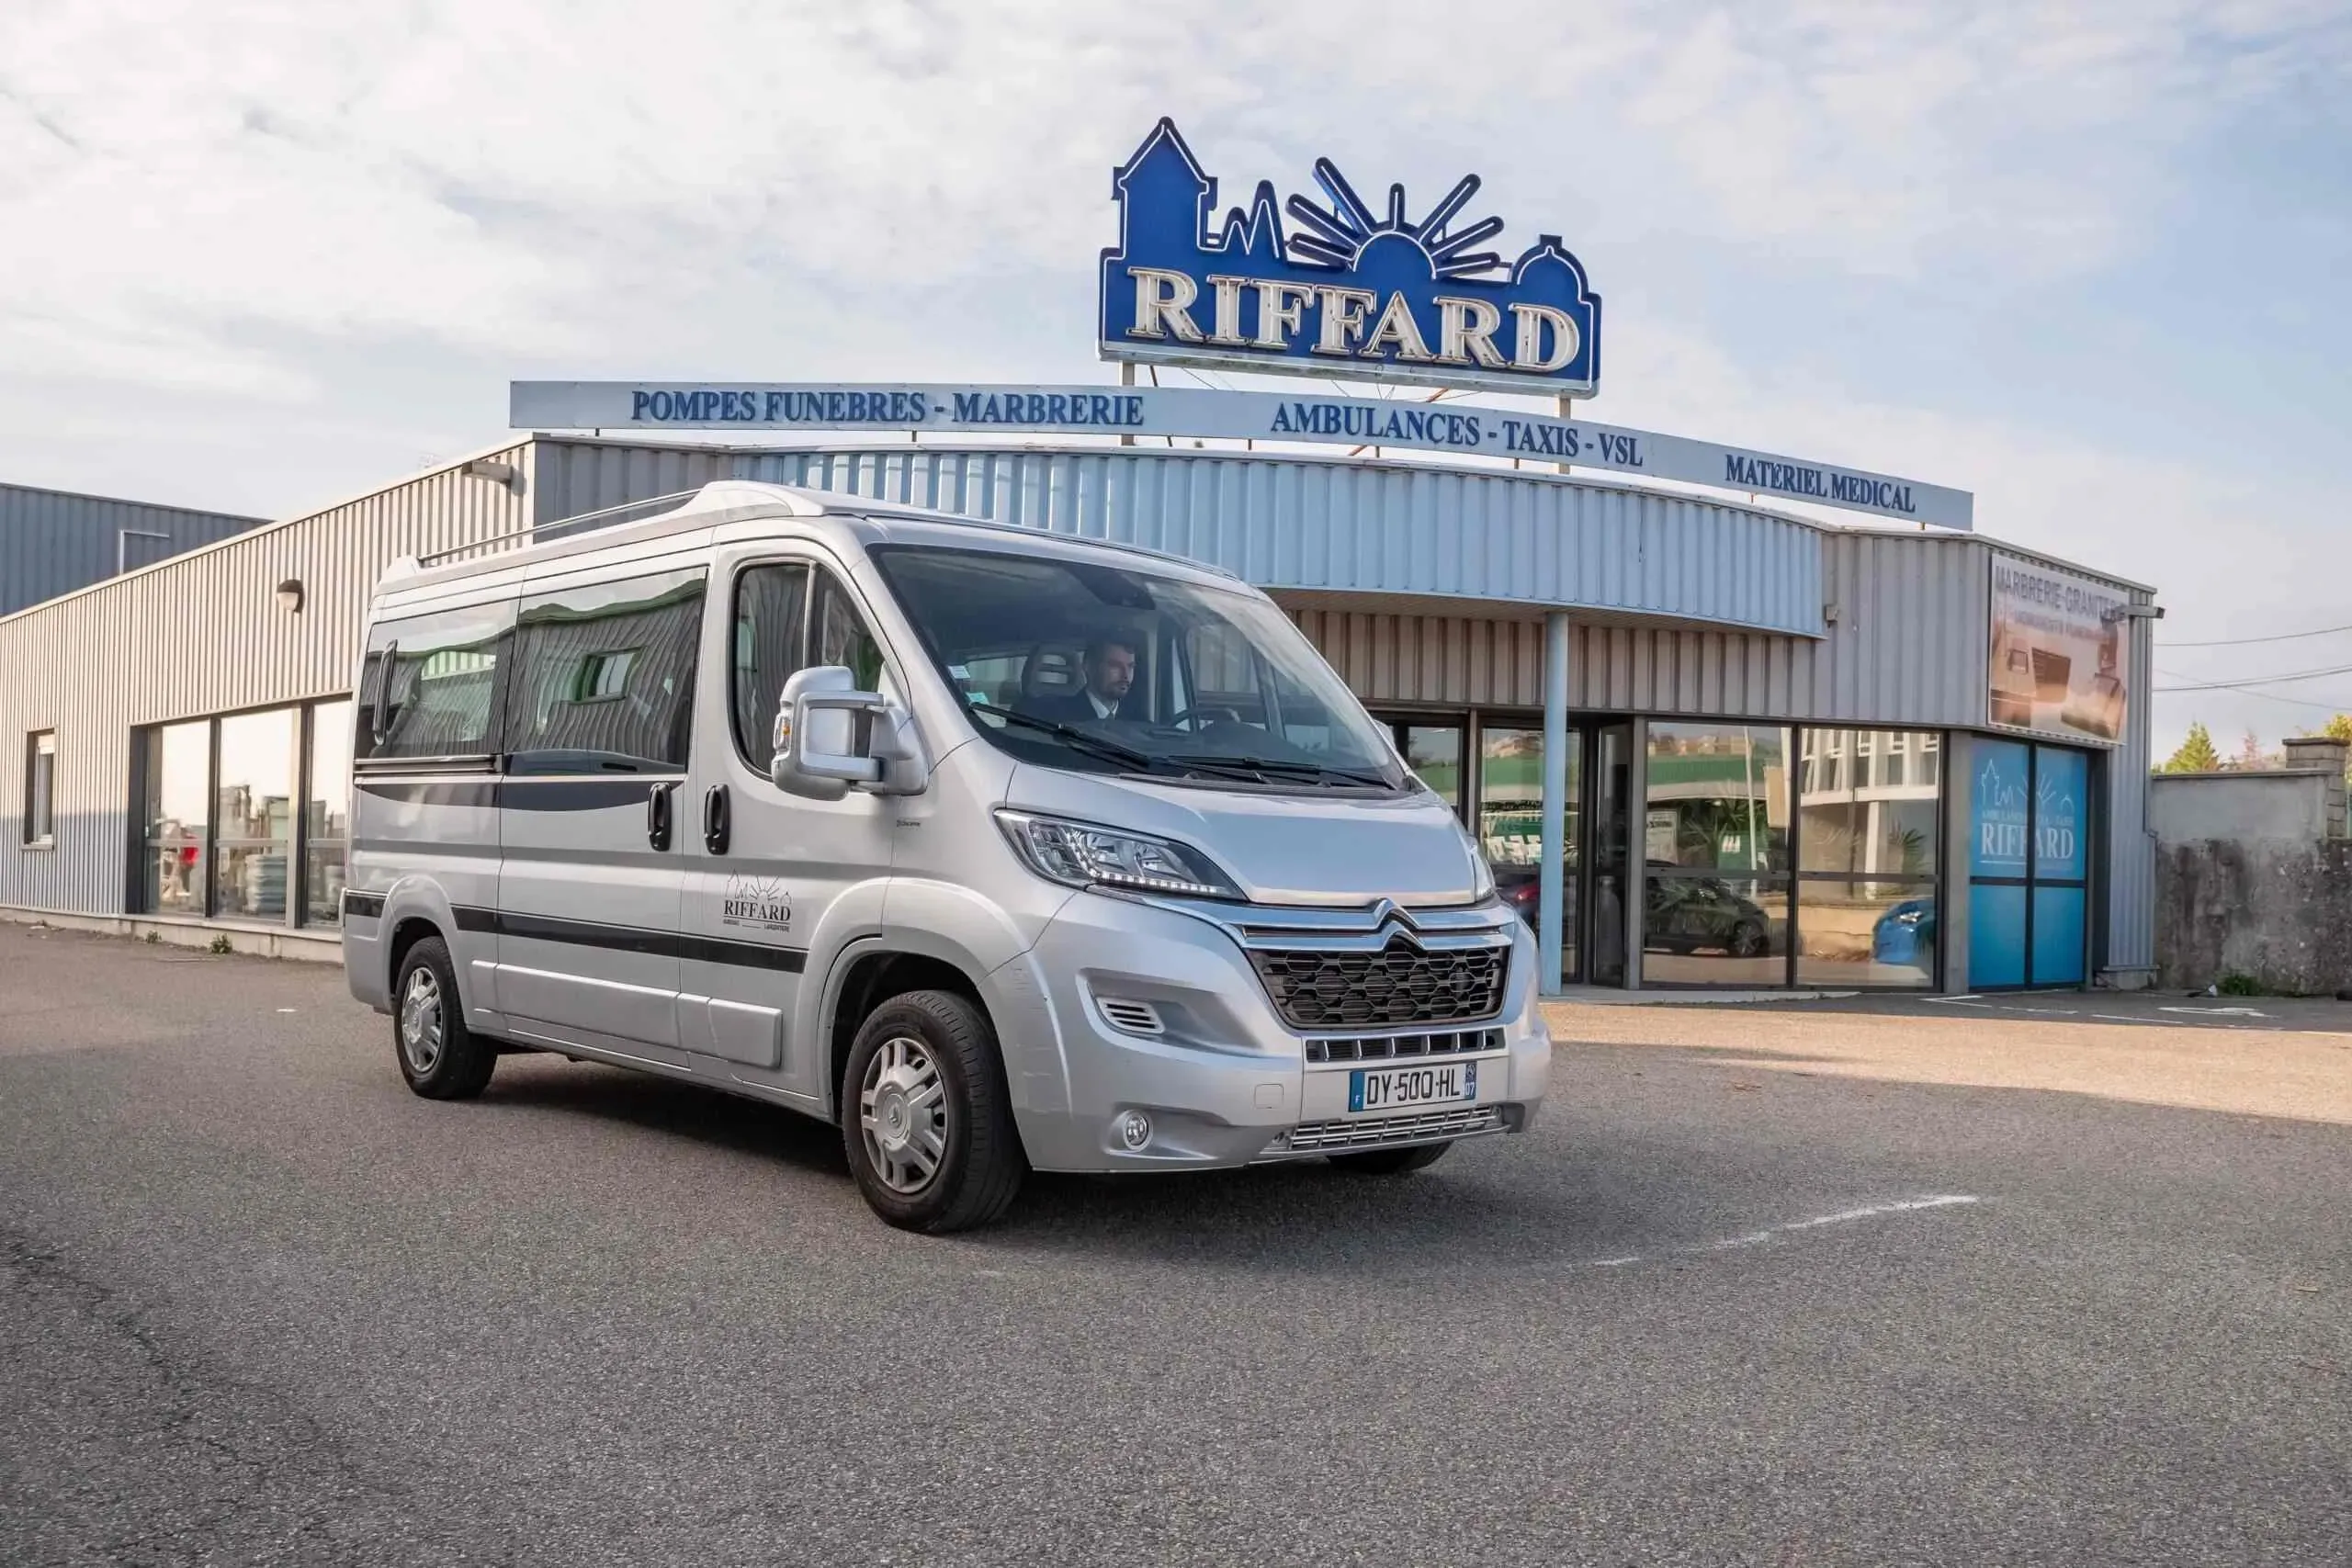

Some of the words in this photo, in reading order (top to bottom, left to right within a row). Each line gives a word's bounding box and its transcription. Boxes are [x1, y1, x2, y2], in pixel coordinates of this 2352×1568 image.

[1125, 265, 1579, 372] RIFFARD
[631, 390, 756, 422] POMPES
[764, 390, 925, 423] FUNEBRES
[952, 392, 1144, 426] MARBRERIE
[1270, 402, 1480, 446] AMBULANCES
[1502, 420, 1578, 457] TAXIS
[1598, 433, 1644, 467] VSL
[1724, 454, 1827, 497] MATERIEL
[1830, 473, 1916, 513] MEDICAL
[723, 899, 791, 921] RIFFARD
[1465, 1081, 1476, 1096] 07
